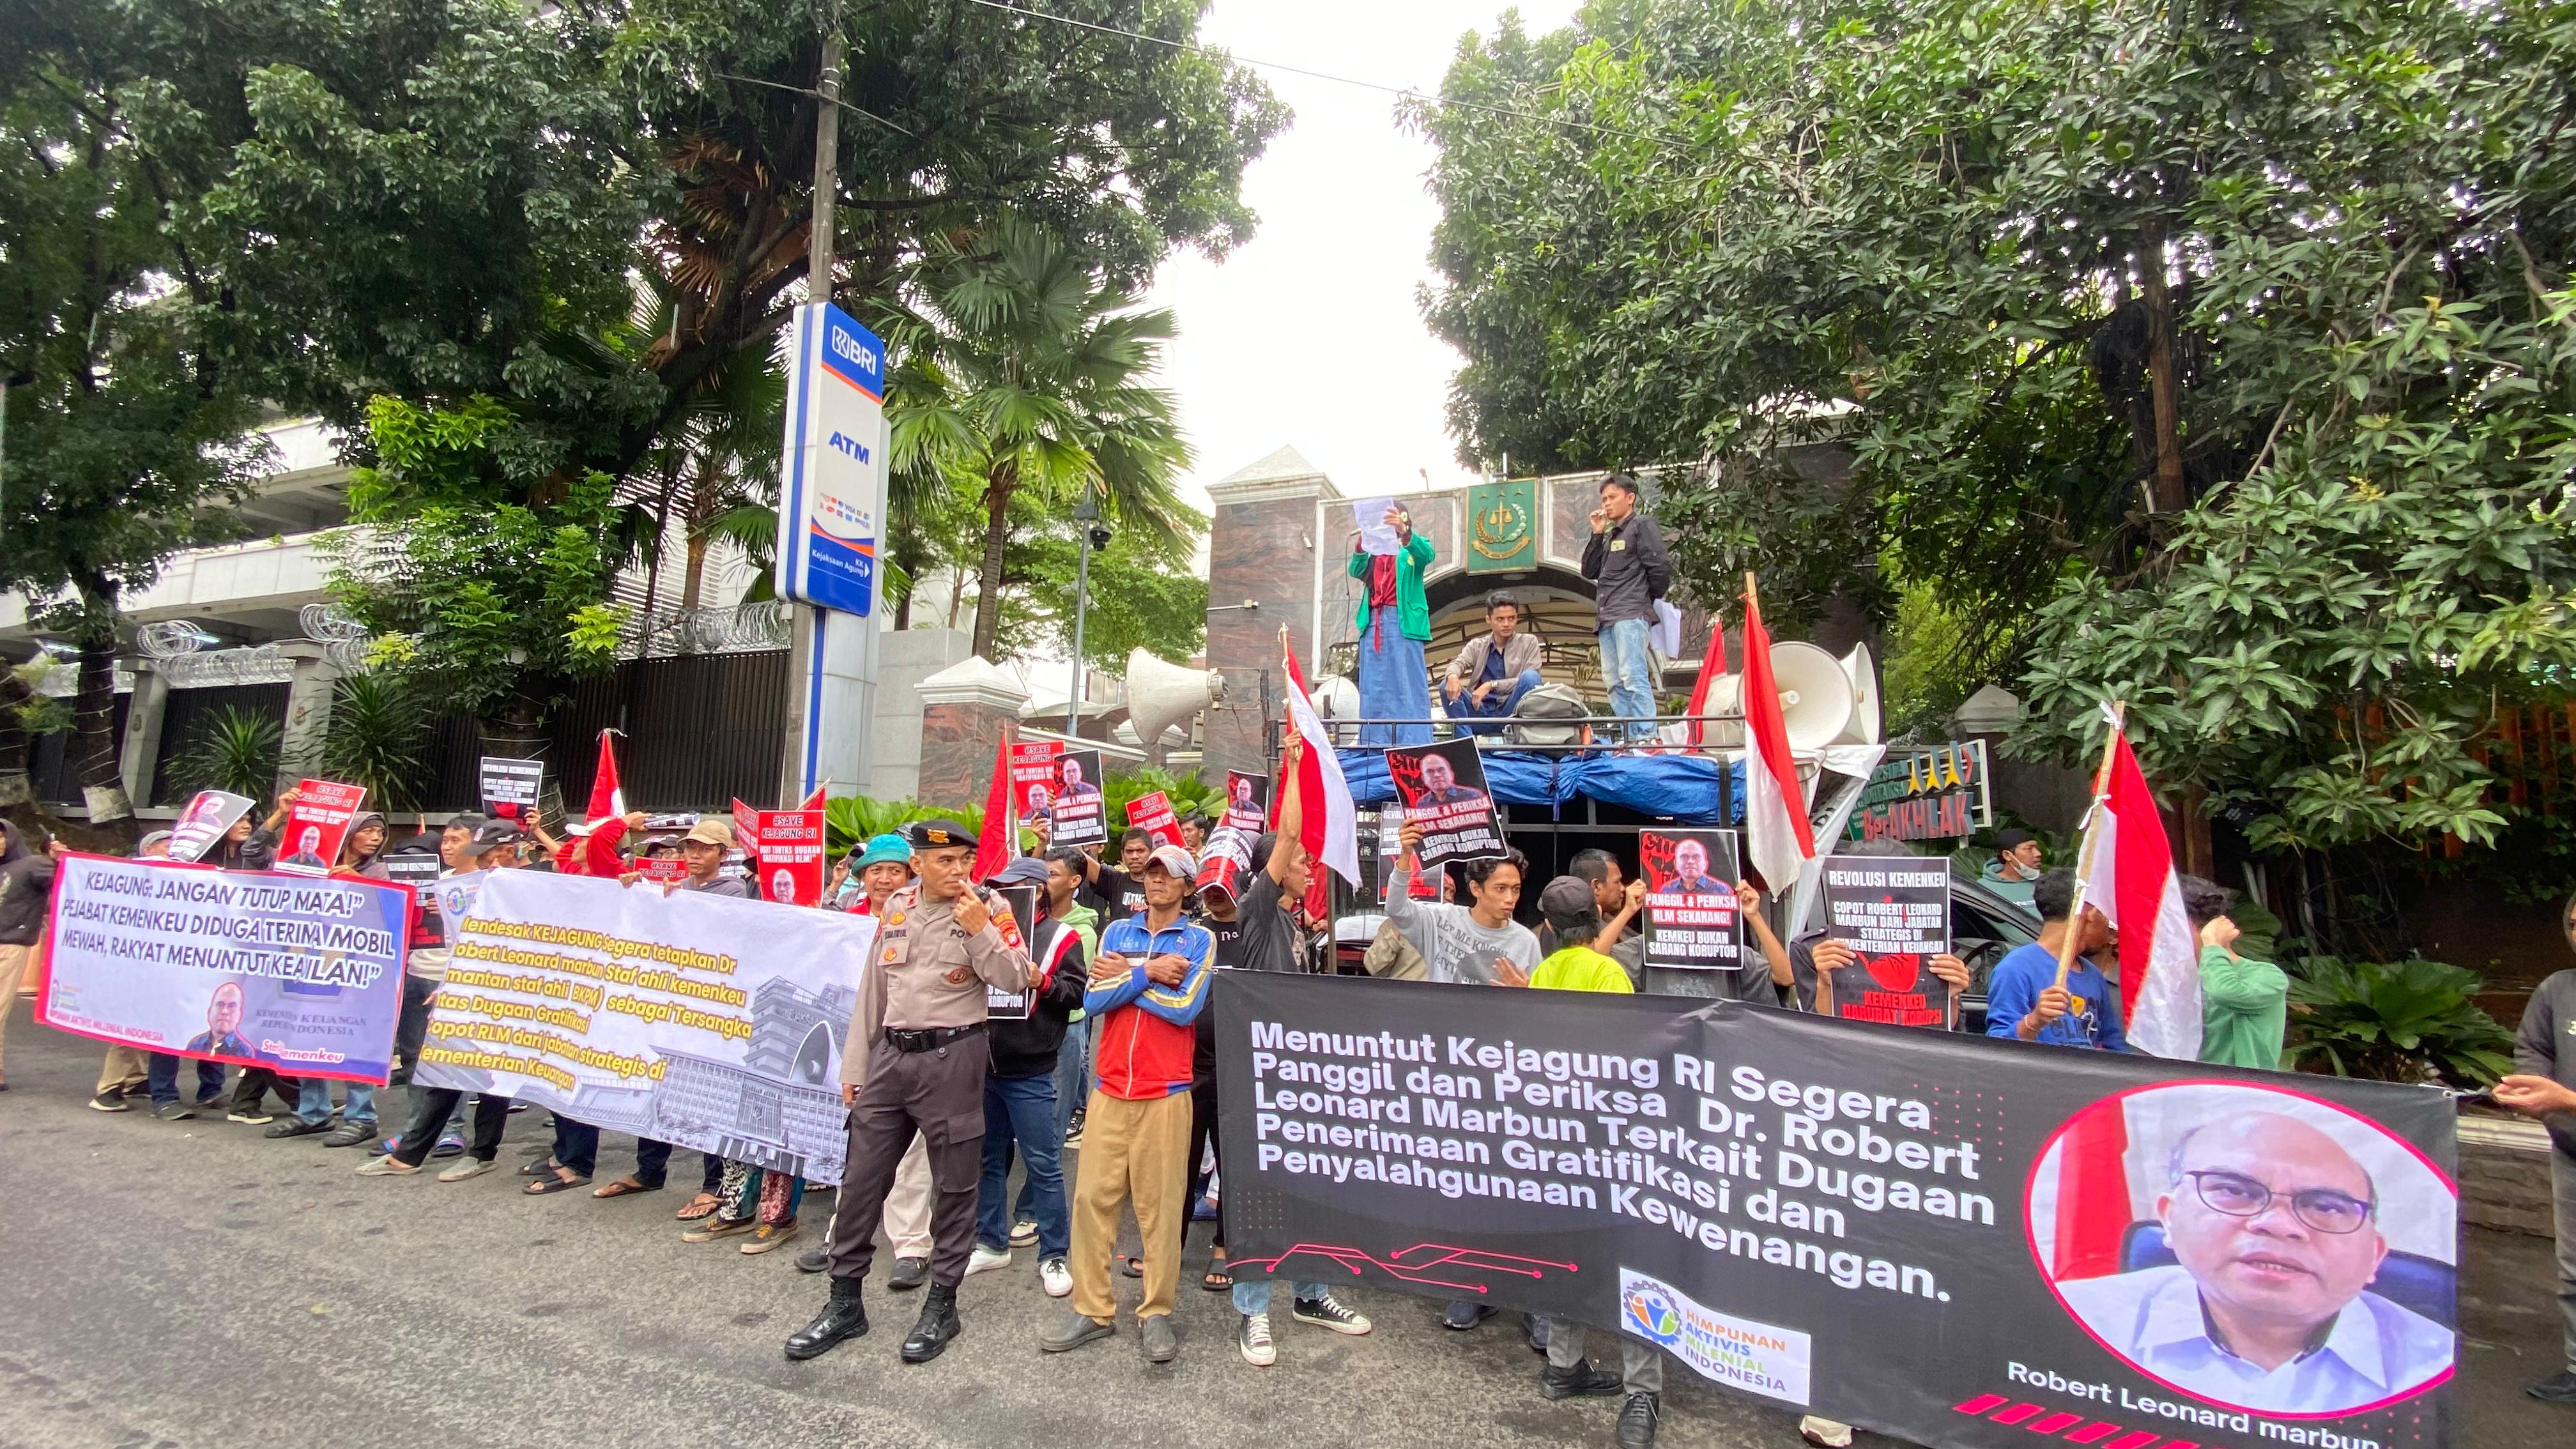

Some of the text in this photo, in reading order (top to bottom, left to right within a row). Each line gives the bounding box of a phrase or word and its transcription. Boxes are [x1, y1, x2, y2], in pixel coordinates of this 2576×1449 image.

[850, 339, 877, 376] BRI
[829, 431, 869, 465] ATM
[812, 549, 864, 578] Kejaksaan Agung
[855, 558, 864, 567] KK
[1014, 755, 1051, 763] KEJAGUNG
[1025, 746, 1050, 754] #SAVE
[1077, 793, 1101, 804] PERIKSA
[1405, 797, 1491, 820] PANGGIL & PERIKSA
[774, 816, 803, 825] #SAVE
[1383, 810, 1405, 819] REVOL
[1438, 811, 1489, 829] SEKARANG!
[1864, 792, 1974, 841] BerAKHLAK
[762, 829, 816, 838] KEJAGUNG RI
[1076, 826, 1103, 838] KORUPTOR
[1423, 829, 1491, 848] KEMKEU BUKAN
[794, 846, 821, 854] DUGAAN
[1420, 842, 1455, 862] SARANG
[1456, 838, 1501, 853] KORUPTOR
[1829, 871, 1945, 887] REVOLUSI KEMENKEU
[85, 871, 153, 898] KEJAGUNG:
[156, 880, 238, 905] JANGAN
[240, 887, 291, 910] TUTUP
[294, 891, 363, 916] MATA!”
[1646, 894, 1737, 908] PANGGIL & PERIKSA
[1653, 910, 1730, 924] RLM SEKARANG!
[1834, 901, 1942, 916] COPOT ROBERT LEONARD
[61, 898, 109, 923] PEJABAT
[109, 905, 188, 933] KEMENKEU
[190, 914, 259, 941] DIDUGA
[328, 926, 394, 956] MOBIL
[1438, 916, 1455, 934] LET
[1457, 928, 1471, 946] ME
[1836, 914, 1942, 928] MARBUN DARI JABATAN
[1656, 930, 1729, 944] KEMKEU BUKAN
[1834, 938, 1944, 953] MENTERIAN KEUANGAN
[1860, 928, 1922, 941] STRATEGIS DI
[61, 928, 107, 958] MEWAH,
[110, 937, 165, 963] RAKYAT
[166, 944, 269, 973] MENUNTUT
[533, 924, 602, 950] KEJAGUNG
[603, 934, 650, 958] Segera
[652, 943, 717, 970] tetapkan
[719, 954, 738, 975] Dr
[1648, 942, 1738, 958] SARANG KORUPTOR
[454, 941, 747, 1008] obert Leonard marbun Staf ahli kemenkeu
[512, 975, 544, 994] staf
[544, 979, 570, 999] ahli
[571, 983, 604, 1012] BKPM)
[607, 995, 674, 1024] sebagai
[675, 1004, 753, 1040] Tersangka
[988, 995, 1023, 1008] KORUPTOR
[1864, 992, 1926, 1009] KEMENKEU
[300, 1015, 368, 1026] KEUANGAN
[471, 995, 535, 1021] Dugaan
[535, 1006, 592, 1035] Gratifikasi
[1843, 1004, 1898, 1025] DARURAT
[124, 1027, 164, 1042] INDONESIA
[288, 1023, 355, 1036] NDONESIA
[477, 1023, 511, 1044] RLM
[512, 1028, 543, 1049] dari
[542, 1031, 581, 1062] jabatan
[579, 1046, 648, 1079] strategis
[648, 1060, 667, 1082] di
[526, 1057, 576, 1092] Keuangan
[1251, 1021, 1929, 1130] Menuntut Kejagung RI Segera
[1253, 1052, 1981, 1181] Panggil dan Periksa Dr. Robert
[1255, 1082, 1995, 1226] Leonard Marbun Terkait Dugaan
[1256, 1112, 1845, 1238] Penerimaan Gratifikasi dan
[1257, 1143, 1951, 1302] Penyalahgunaan Kewenangan.
[1686, 1308, 1786, 1352] HIMPUNAN
[1686, 1322, 1751, 1356] AKTIVIS
[1685, 1333, 1767, 1374] MILENIAL
[1685, 1346, 1787, 1392] INDONESIA
[2007, 1361, 2380, 1449] Robert Leonard marbun
